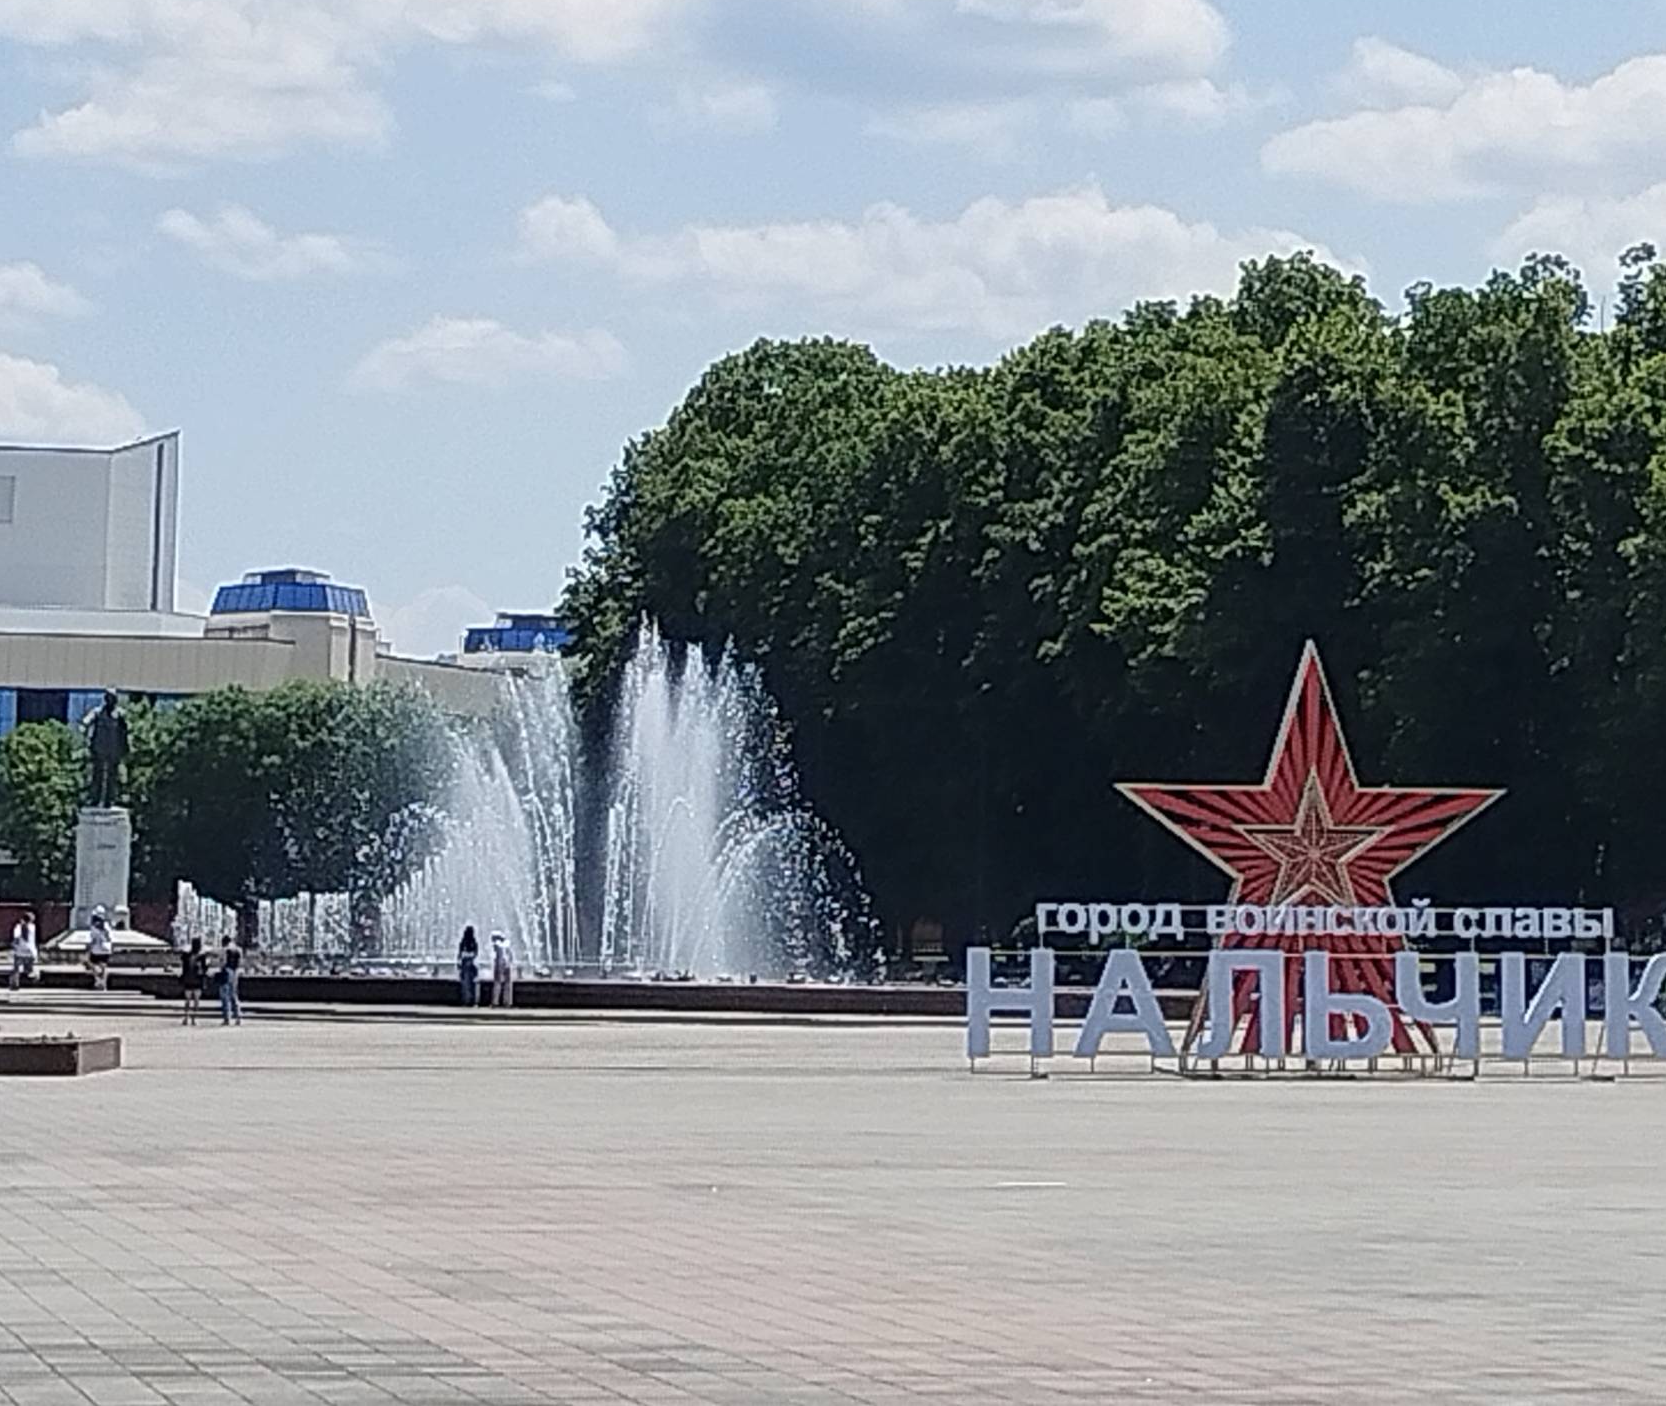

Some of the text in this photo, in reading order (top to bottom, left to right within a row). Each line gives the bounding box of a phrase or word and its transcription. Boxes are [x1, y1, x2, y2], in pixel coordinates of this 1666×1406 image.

[1036, 898, 1614, 944] город воинской славы
